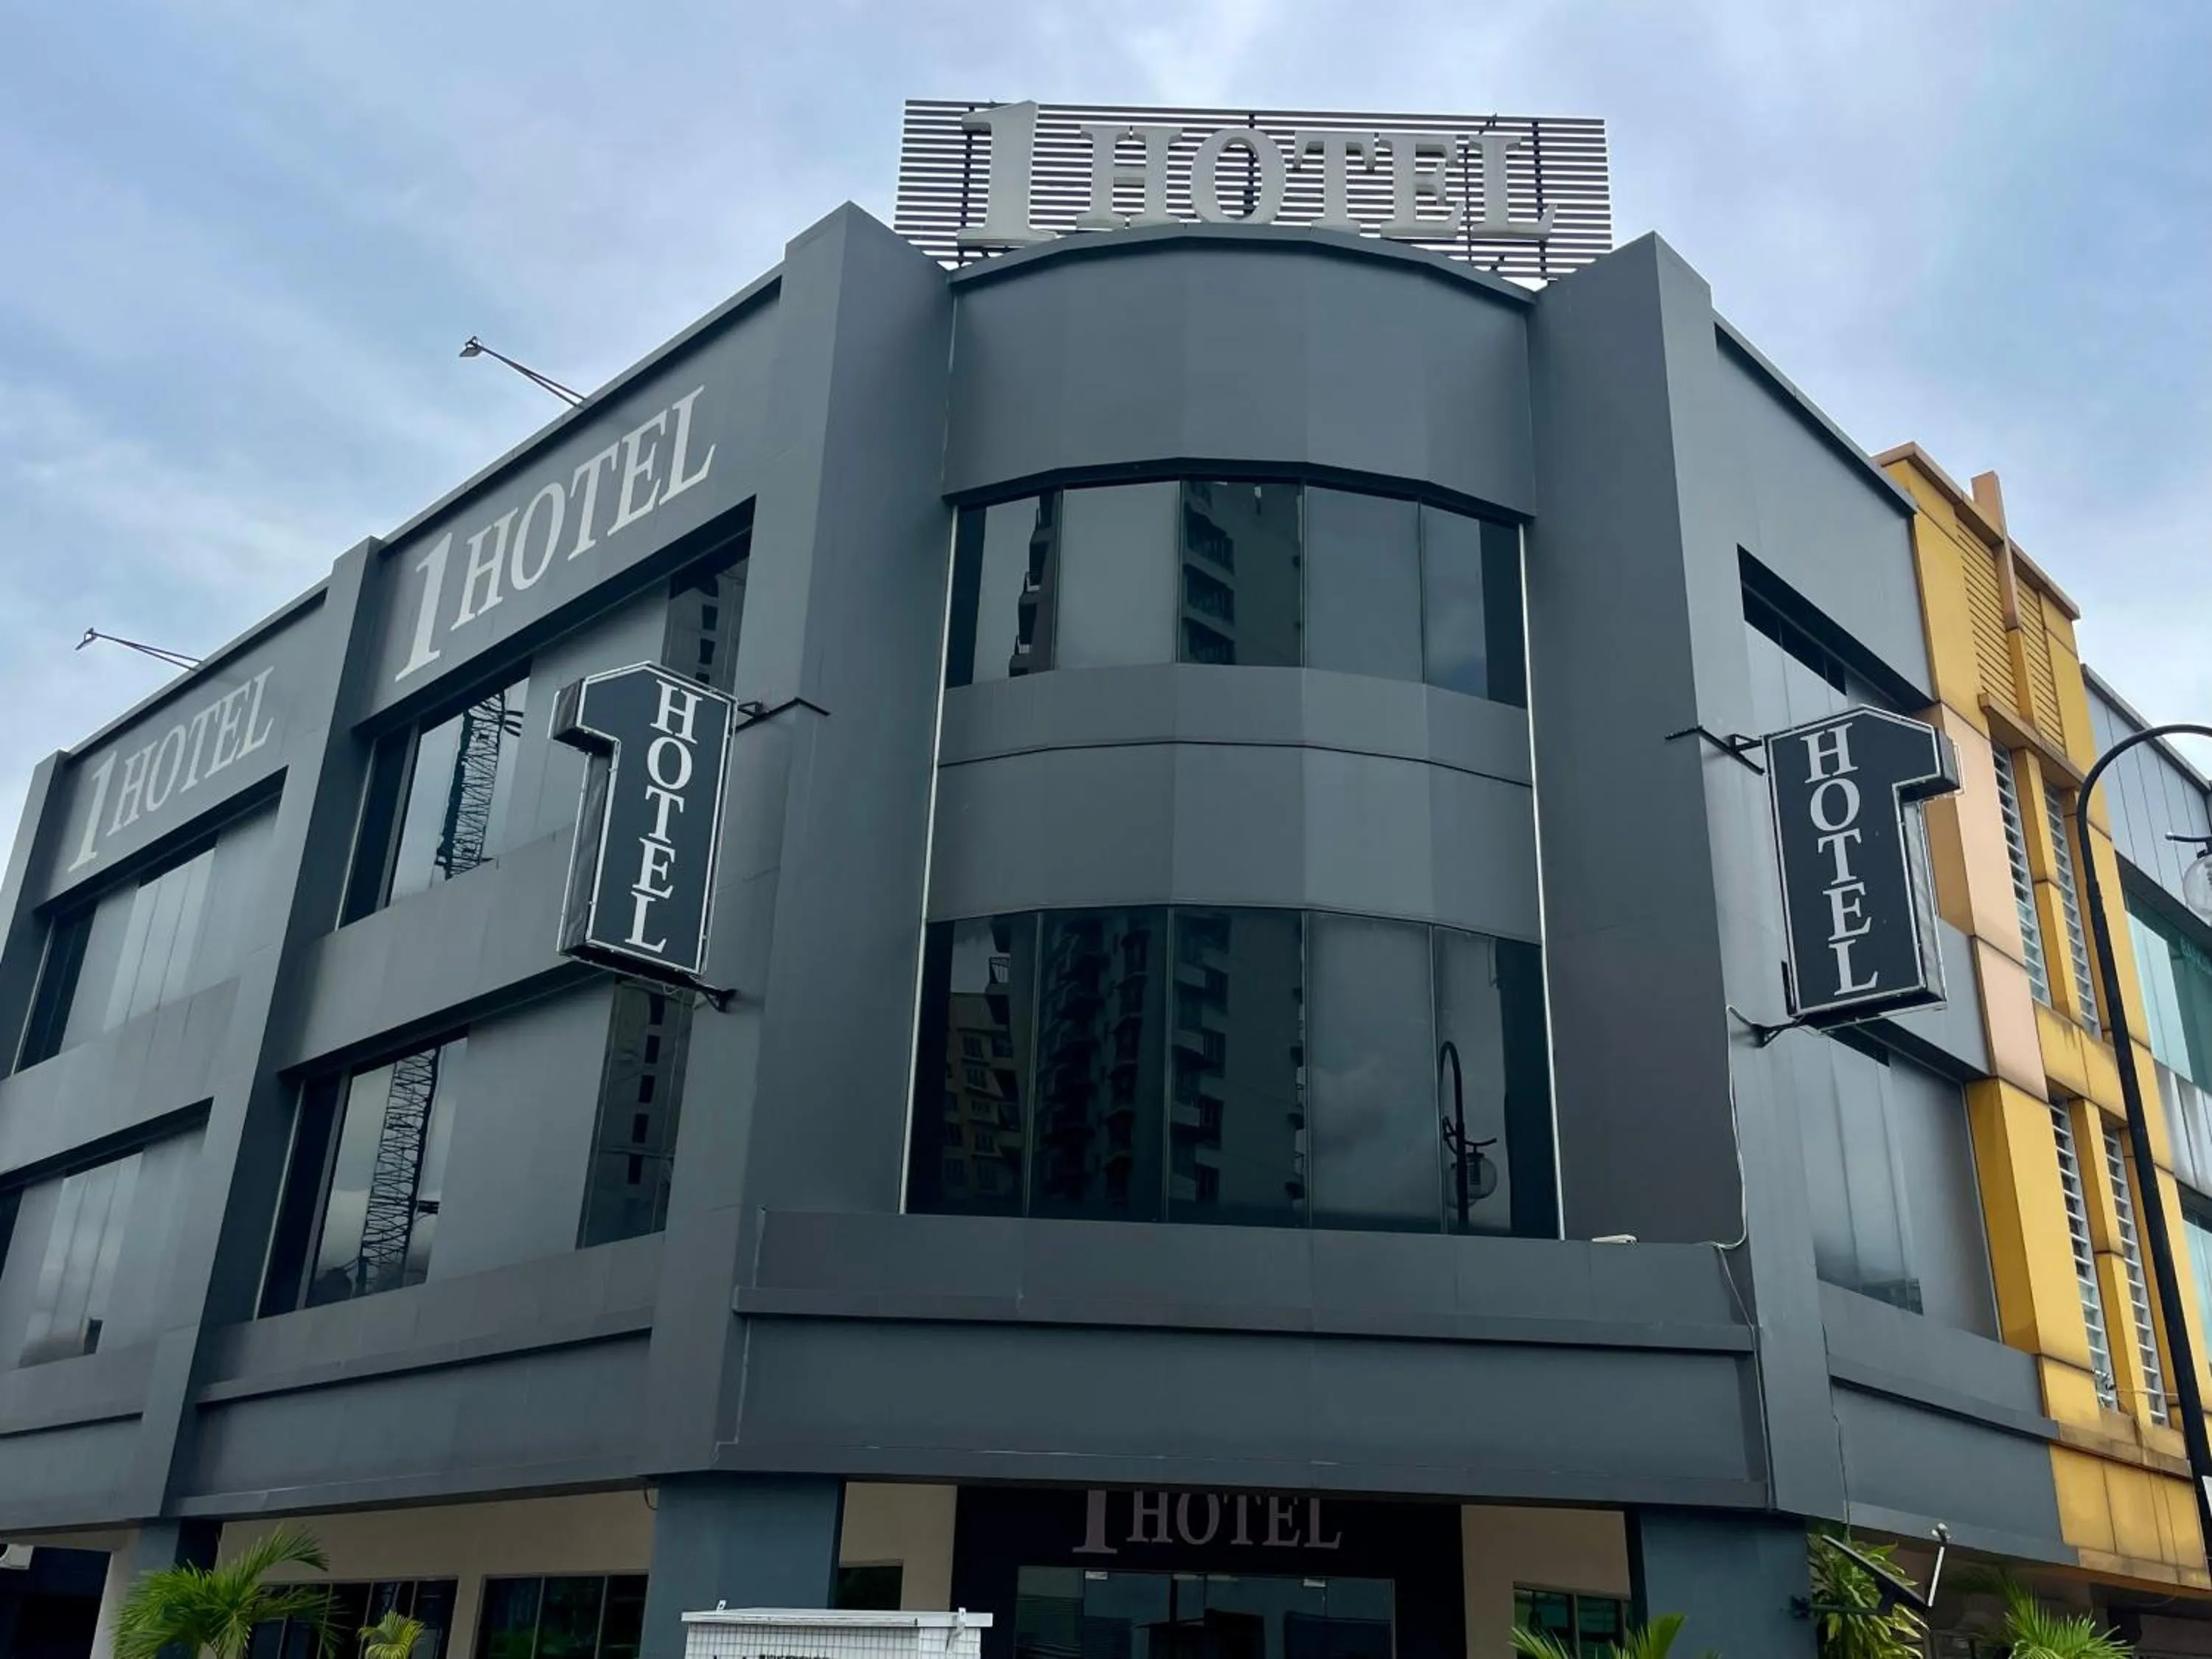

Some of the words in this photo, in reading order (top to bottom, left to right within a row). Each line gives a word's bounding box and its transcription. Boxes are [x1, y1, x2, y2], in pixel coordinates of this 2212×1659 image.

[957, 100, 1057, 247] 1
[1075, 124, 1557, 241] HOTEL
[395, 532, 453, 682] 1
[451, 384, 716, 631] HOTEL
[68, 751, 117, 872] 1
[106, 665, 274, 838] HOTEL
[625, 679, 703, 953] HOTEL
[1800, 722, 1879, 997] HOTEL
[1072, 1489, 1118, 1554] 1
[1126, 1490, 1343, 1549] HOTEL
